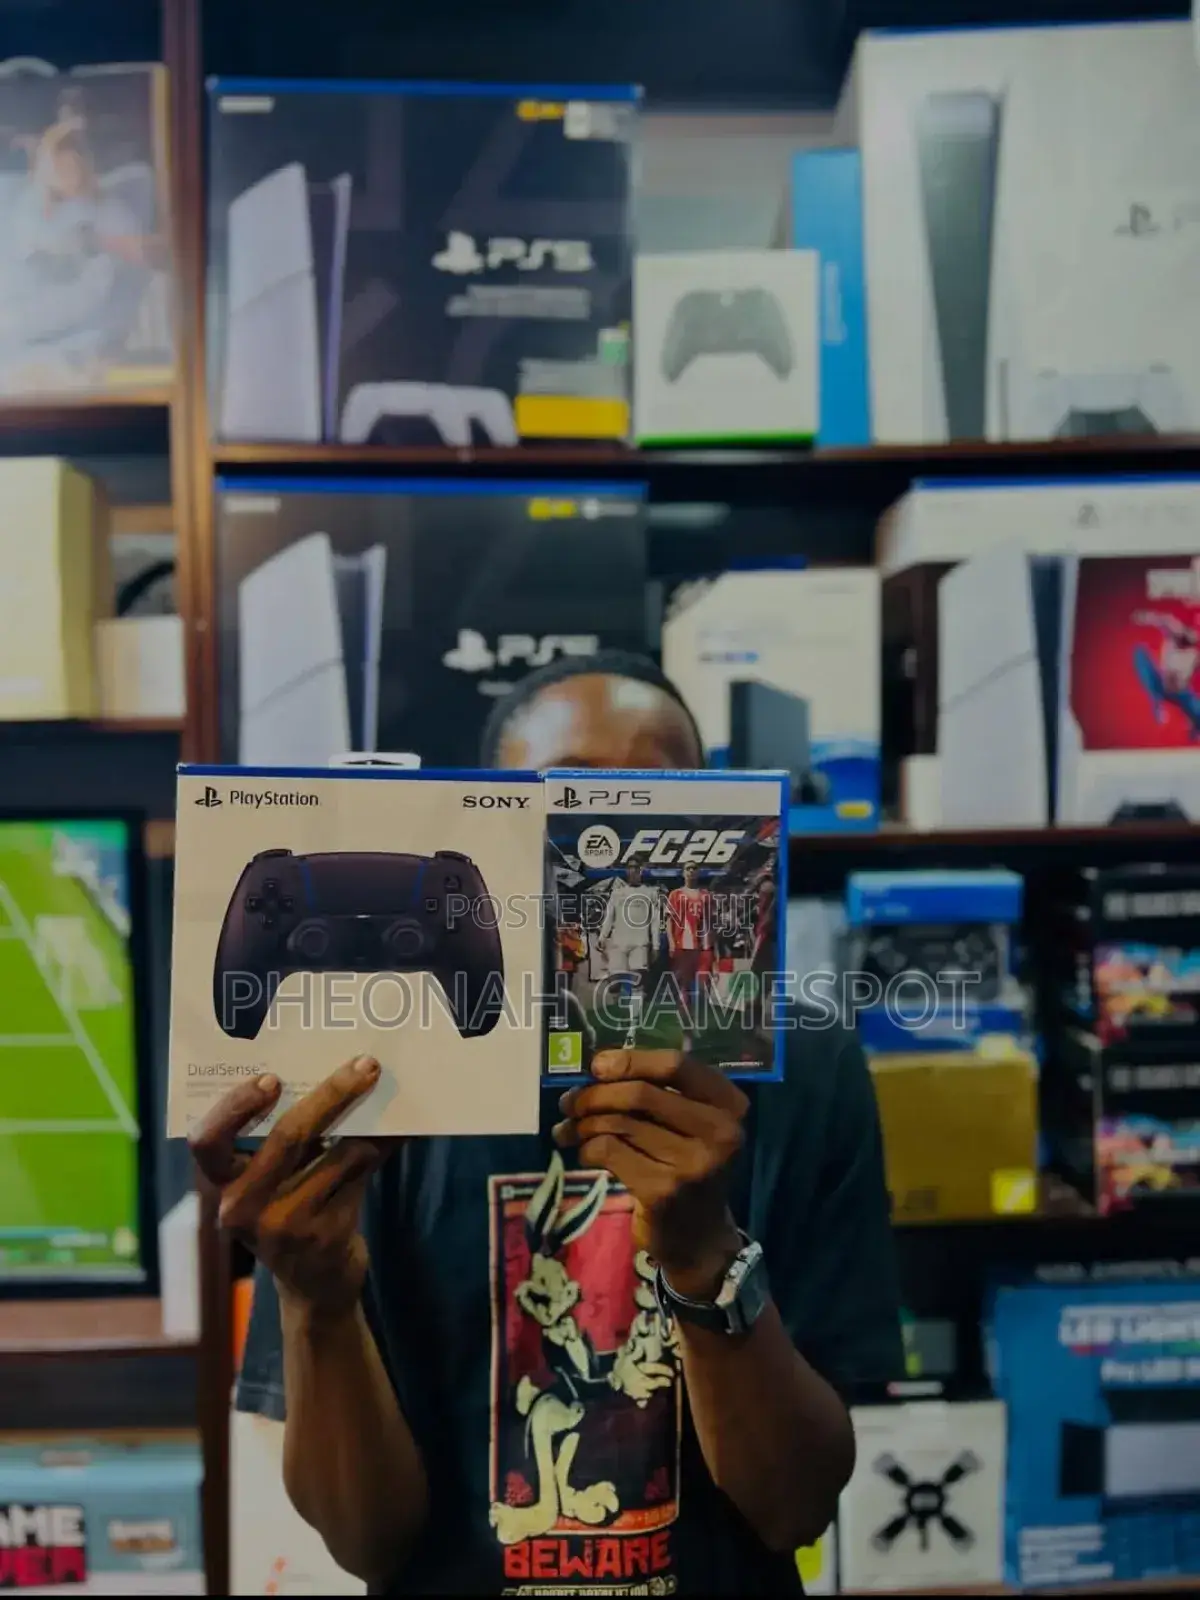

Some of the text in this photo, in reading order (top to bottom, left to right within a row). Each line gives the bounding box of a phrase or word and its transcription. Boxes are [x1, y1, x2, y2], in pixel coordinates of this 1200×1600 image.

[230, 790, 319, 808] PlayStation
[462, 796, 529, 809] SONY
[589, 790, 652, 806] PS5
[586, 835, 613, 848] EA
[584, 848, 613, 857] SPORTS
[558, 1037, 572, 1062] 3
[188, 1063, 260, 1077] DualSense
[504, 1530, 671, 1578] BEWARE
